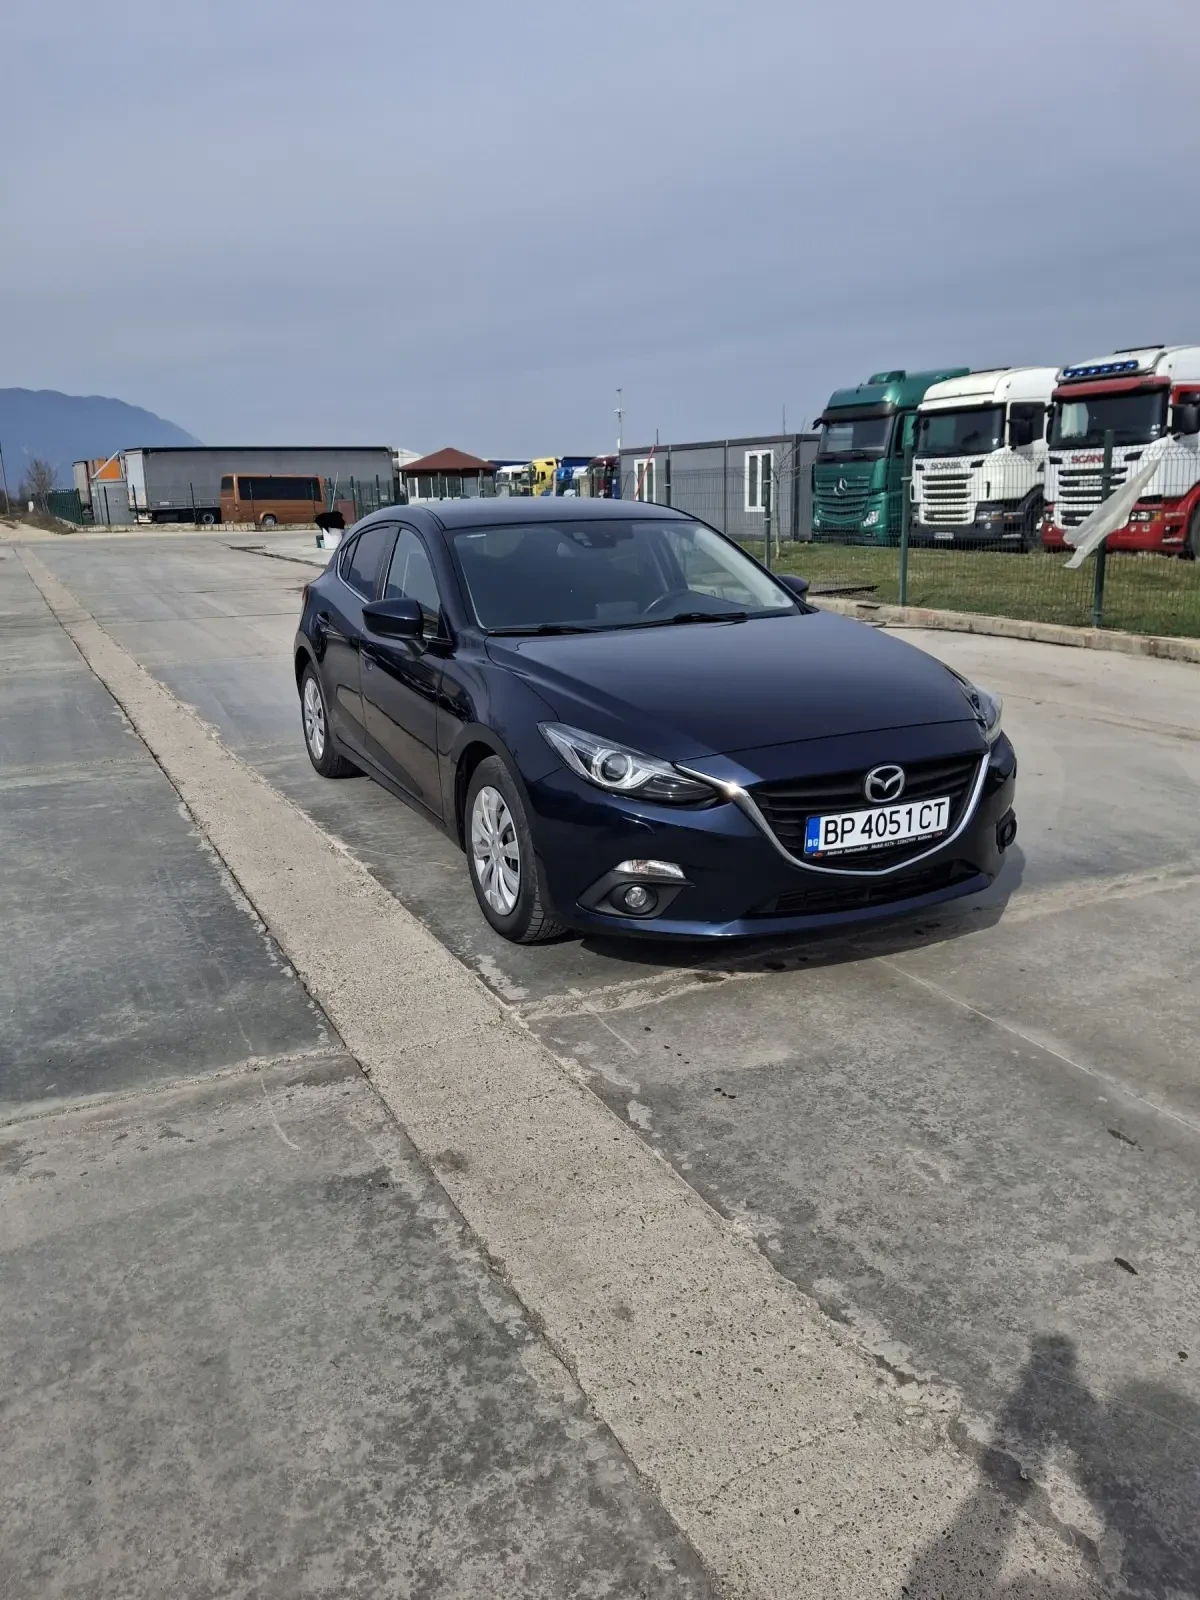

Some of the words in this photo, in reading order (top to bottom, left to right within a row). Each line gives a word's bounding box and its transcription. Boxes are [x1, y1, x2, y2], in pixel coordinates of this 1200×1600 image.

[1071, 454, 1105, 464] SCANI
[824, 817, 856, 845] BP
[860, 807, 913, 839] 4051
[919, 801, 946, 830] CT
[807, 838, 819, 848] BG
